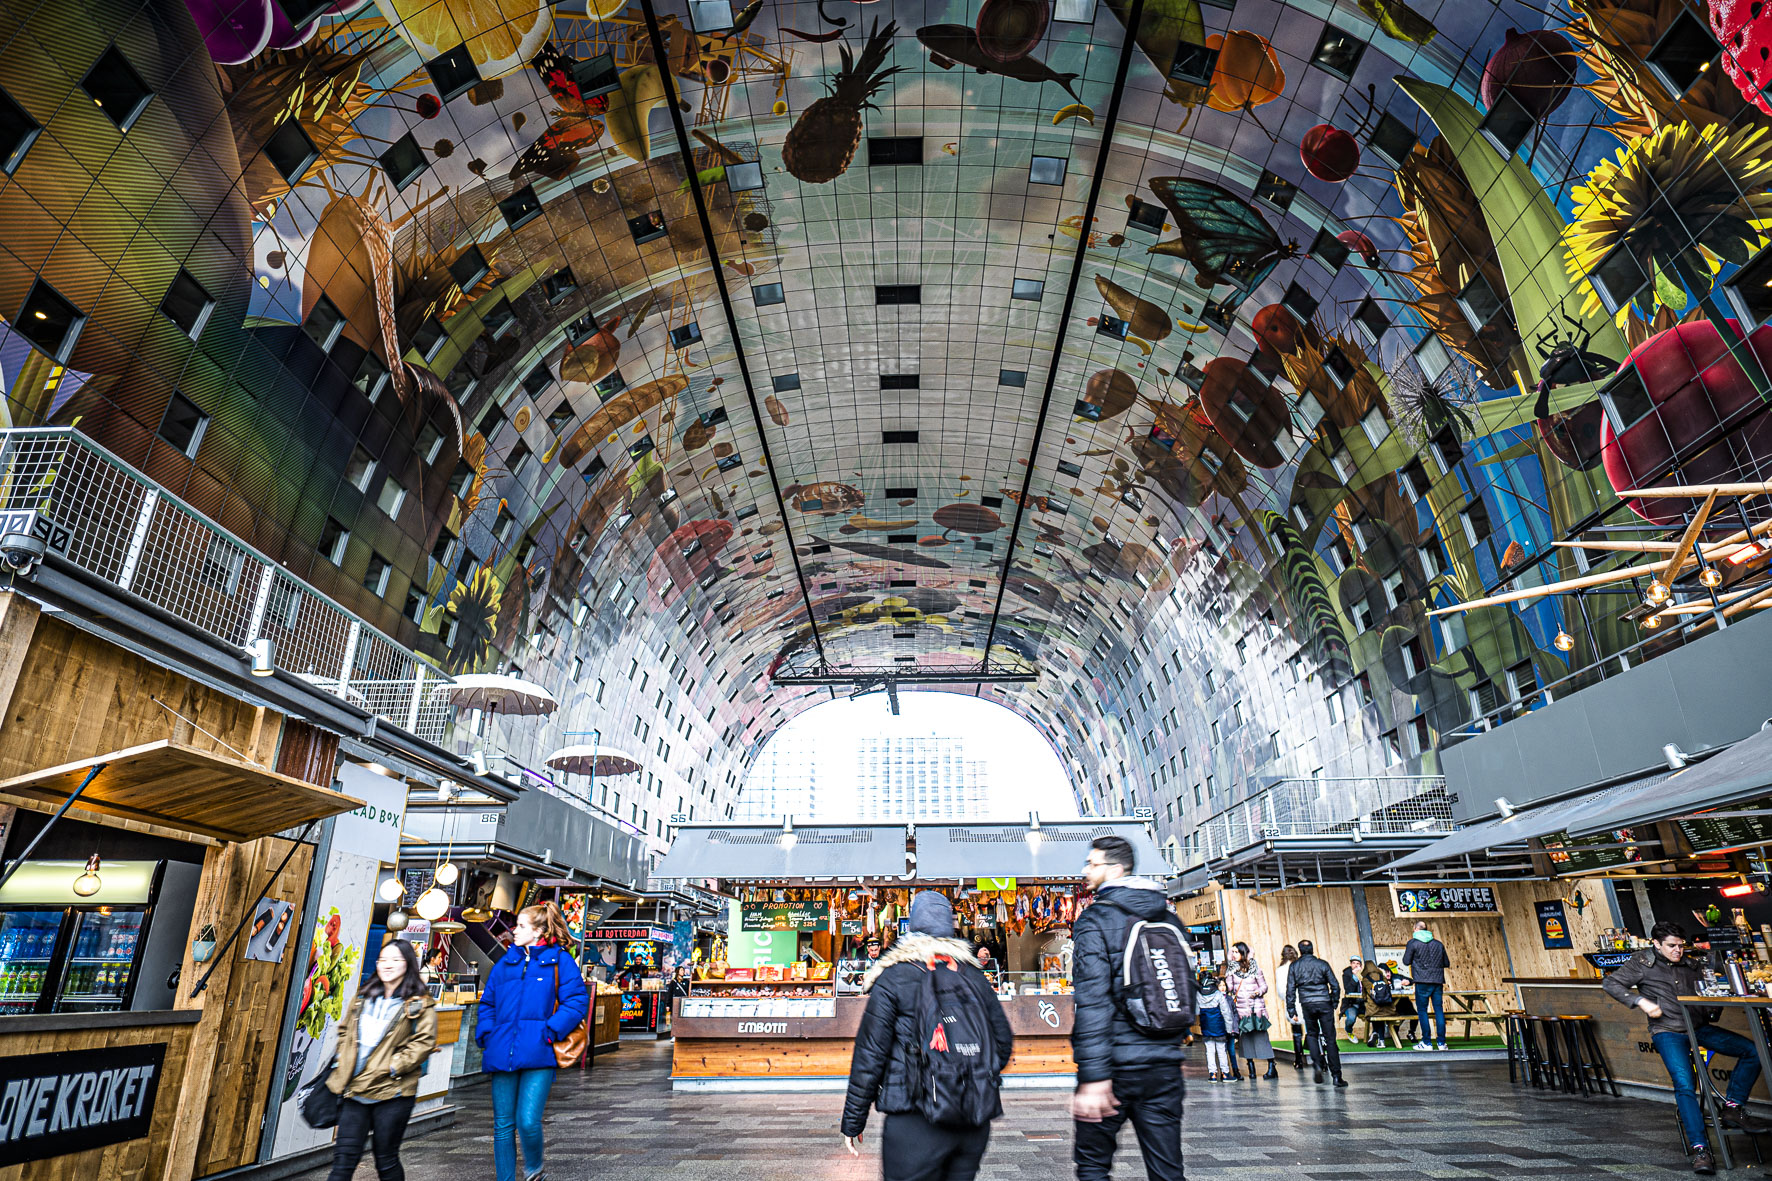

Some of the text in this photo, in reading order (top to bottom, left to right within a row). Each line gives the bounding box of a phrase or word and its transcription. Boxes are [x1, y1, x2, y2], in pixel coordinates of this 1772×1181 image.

[481, 813, 498, 823] 86
[670, 813, 687, 823] 56
[1265, 829, 1280, 837] 32
[1440, 888, 1492, 903] COFFEE
[762, 902, 805, 910] PROMOTION
[1453, 902, 1469, 911] stay
[605, 929, 647, 938] ROTTERDAM
[738, 1022, 788, 1034] EMBOTIT
